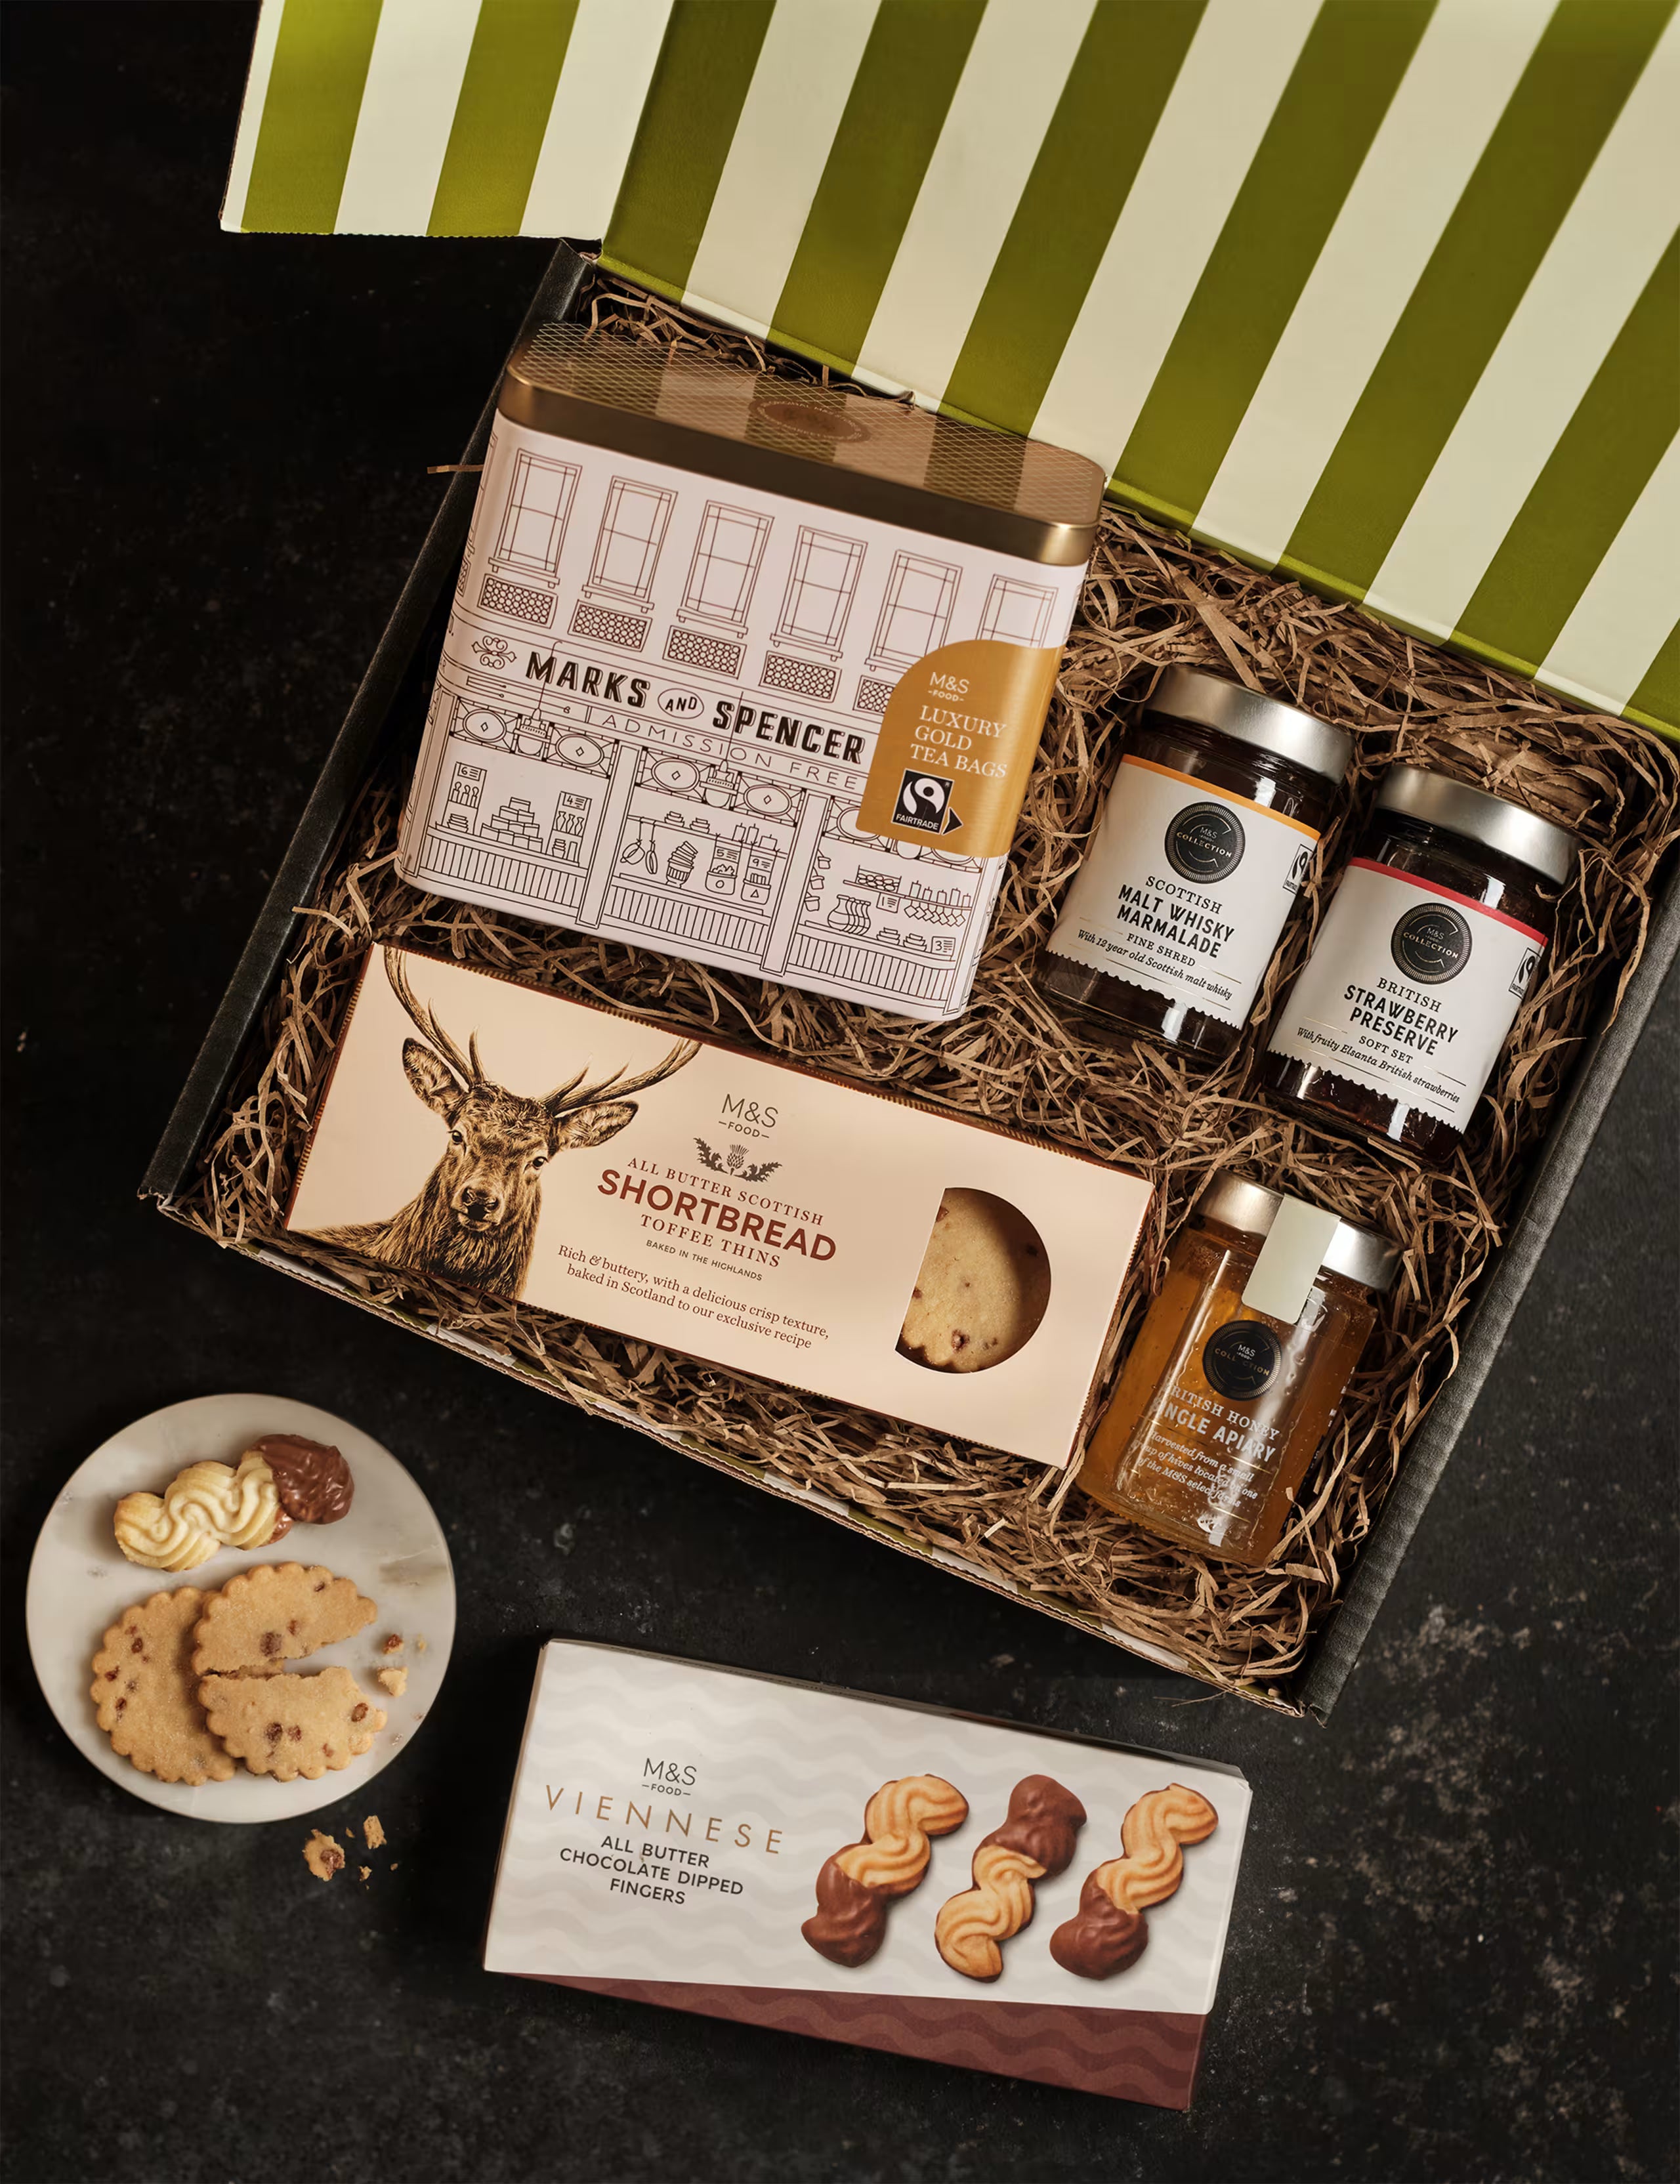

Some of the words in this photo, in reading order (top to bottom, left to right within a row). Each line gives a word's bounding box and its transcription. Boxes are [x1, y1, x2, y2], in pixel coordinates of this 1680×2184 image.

[929, 671, 970, 694] M&S
[526, 651, 651, 708] MARKS
[665, 696, 698, 712] AND
[712, 700, 866, 764] SPENCER
[919, 705, 1007, 738] LUXURY
[602, 715, 772, 768] ADMISSION
[789, 761, 858, 789] FREE
[915, 725, 973, 750] GOLD
[910, 743, 949, 766] TEA
[954, 755, 1007, 778] BAGS
[895, 813, 939, 830] FAIRTRADE
[1177, 831, 1232, 858] COLLECTION
[1118, 884, 1164, 913] MALT
[1169, 903, 1235, 942] WHISKY
[1145, 875, 1223, 914] SCOTTISH
[1117, 904, 1221, 958] MARMALADE
[1403, 932, 1459, 959] COLLECTION
[1427, 927, 1444, 940] M&S
[1078, 929, 1095, 944] With
[1096, 938, 1106, 948] 12
[1105, 942, 1129, 956] year
[1129, 950, 1144, 963] old
[1145, 956, 1184, 979] Scottish
[1185, 974, 1208, 989] malt
[1206, 982, 1232, 1001] whisky
[1126, 933, 1155, 950] FINE
[1156, 945, 1196, 967] SHRED
[1376, 976, 1442, 1013] BRITISH
[1343, 984, 1459, 1043] STRAWBERRY
[1349, 1007, 1438, 1056] PRESERVE
[1297, 1027, 1314, 1040] With
[1312, 1033, 1340, 1052] fruity
[1339, 1043, 1378, 1066] Elsanta
[1378, 1060, 1413, 1082] British
[1412, 1076, 1460, 1104] strawberries
[1358, 1035, 1389, 1054] SOFT
[1391, 1049, 1414, 1064] SET
[721, 1093, 779, 1128] M&S
[727, 1121, 761, 1139] FOOD
[627, 1157, 660, 1175] ALL
[665, 1167, 732, 1198] BUTTER
[738, 1190, 824, 1226] SCOTTISH
[597, 1169, 837, 1261] SHORTBREAD
[640, 1213, 715, 1248] TOFFEE
[721, 1238, 781, 1268] THINS
[646, 1239, 677, 1255] BAKED
[679, 1249, 690, 1259] IN
[692, 1253, 709, 1265] THE
[711, 1259, 763, 1281] HIGHLANDS
[557, 1244, 587, 1266] Rich
[589, 1254, 602, 1267] &
[601, 1257, 650, 1284] buttery,
[653, 1275, 682, 1295] with
[682, 1285, 690, 1295] a
[692, 1286, 747, 1312] delicious
[749, 1304, 781, 1324] crisp
[782, 1314, 830, 1340] texture,
[566, 1263, 604, 1286] baked
[606, 1276, 620, 1290] in
[621, 1280, 675, 1308] Scotland
[677, 1299, 690, 1312] to
[692, 1304, 715, 1319] our
[716, 1308, 772, 1337] exclusive
[774, 1327, 812, 1350] recipe
[1215, 1348, 1270, 1376] COLLCTION
[1238, 1344, 1256, 1358] M&S
[1154, 1397, 1211, 1435] NGLE
[1213, 1425, 1276, 1463] APIARY
[1163, 1382, 1225, 1418] RITISH
[1226, 1410, 1280, 1441] HONEY
[1150, 1431, 1197, 1458] Harvested
[1192, 1450, 1219, 1468] from
[1146, 1460, 1162, 1473] the
[1161, 1466, 1188, 1484] M&S
[1158, 1451, 1171, 1461] of
[1167, 1452, 1193, 1471] hives
[1242, 1488, 1259, 1500] one
[643, 1757, 697, 1786] M&S
[650, 1783, 682, 1796] FOOD
[546, 1784, 783, 1855] VIENNESE
[560, 1847, 671, 1881] CHOCOLATE
[677, 1870, 744, 1895] DIPPED
[600, 1836, 634, 1854] ALL
[641, 1843, 710, 1869] BUTTER
[609, 1878, 686, 1905] FINGERS
